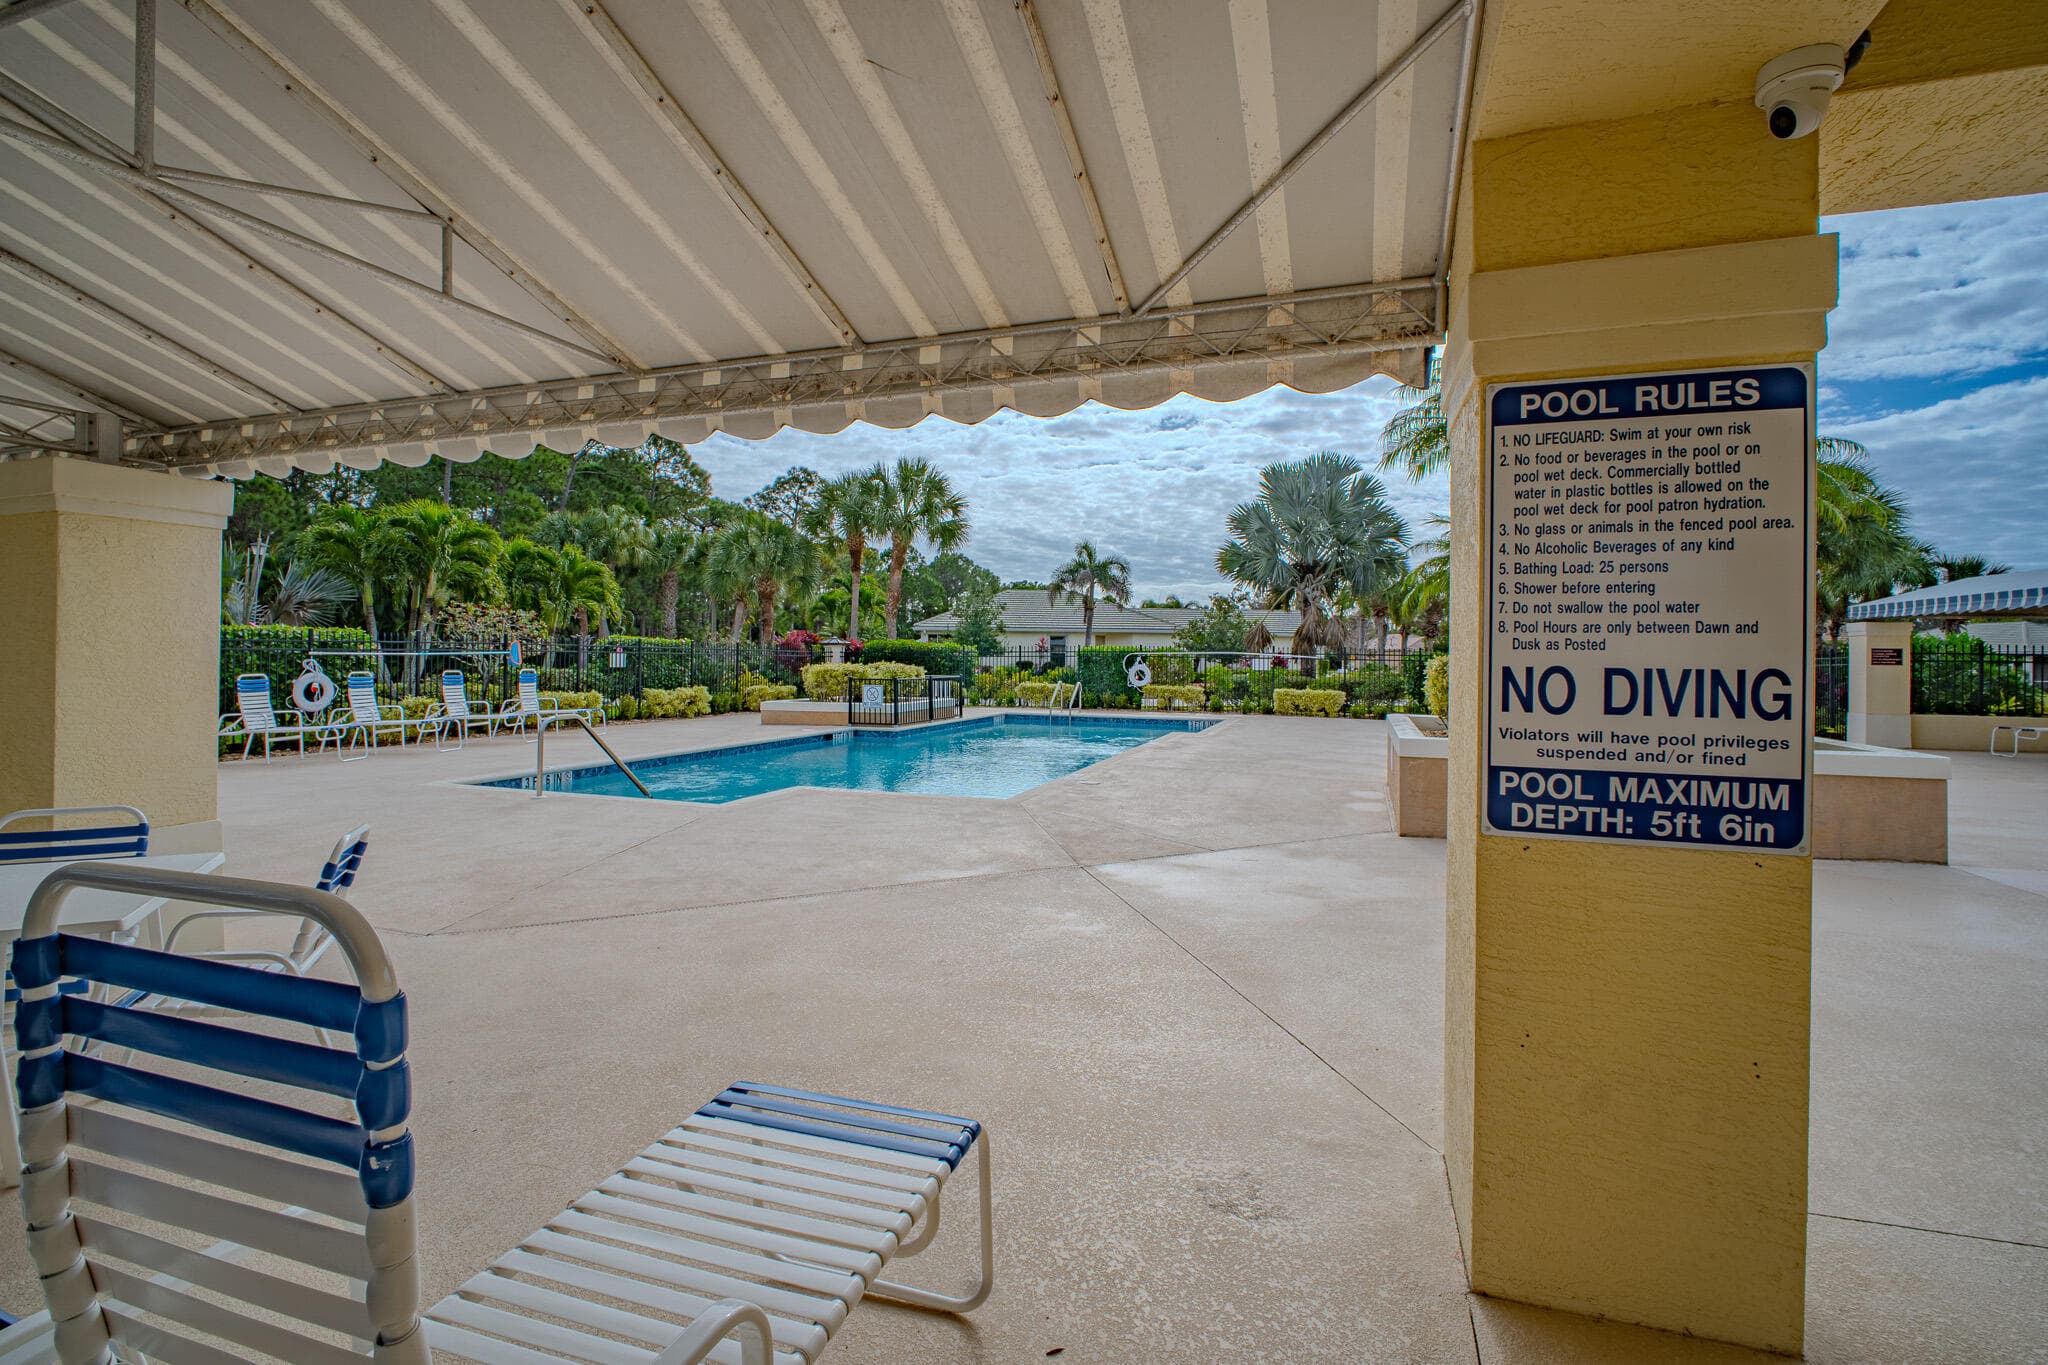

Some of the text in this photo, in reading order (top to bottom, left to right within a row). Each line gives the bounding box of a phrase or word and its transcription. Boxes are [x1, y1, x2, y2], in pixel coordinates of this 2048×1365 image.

[1521, 378, 1760, 418] POOL RULES
[1501, 421, 1751, 447] 1. NO LIFEGUARD: Swim at your own risk
[1500, 443, 1760, 466] 2. No food or beverages in the pool or on
[1514, 460, 1740, 485] pool wet deck. Commercially bottled
[1515, 478, 1769, 500] water in plastic bottles is allowed on the
[1514, 496, 1765, 519] pool wet deck for pool patron hydration.
[1499, 516, 1794, 538] 3. No glass or animals in the fenced pool area.
[1499, 537, 1734, 555] 4. No Alcoholic Beverages of any kind
[1499, 561, 1669, 577] 5. Bathing Load: 25 persons
[1499, 581, 1655, 596] 6. Shower before entering
[1498, 601, 1700, 616] 7. Do not swallow the pool water
[1498, 621, 1758, 636] 8. Pool Hours are only between Dawn and
[1513, 638, 1606, 650] Dusk as Posted
[1502, 666, 1792, 721] NO DIVING
[1499, 728, 1789, 752] Violators will have pool privileges
[1537, 748, 1746, 766] suspended and/or fined
[1499, 771, 1789, 810] POOL MAXIMUM
[1511, 802, 1774, 843] DEPTH: 5ft 6in
